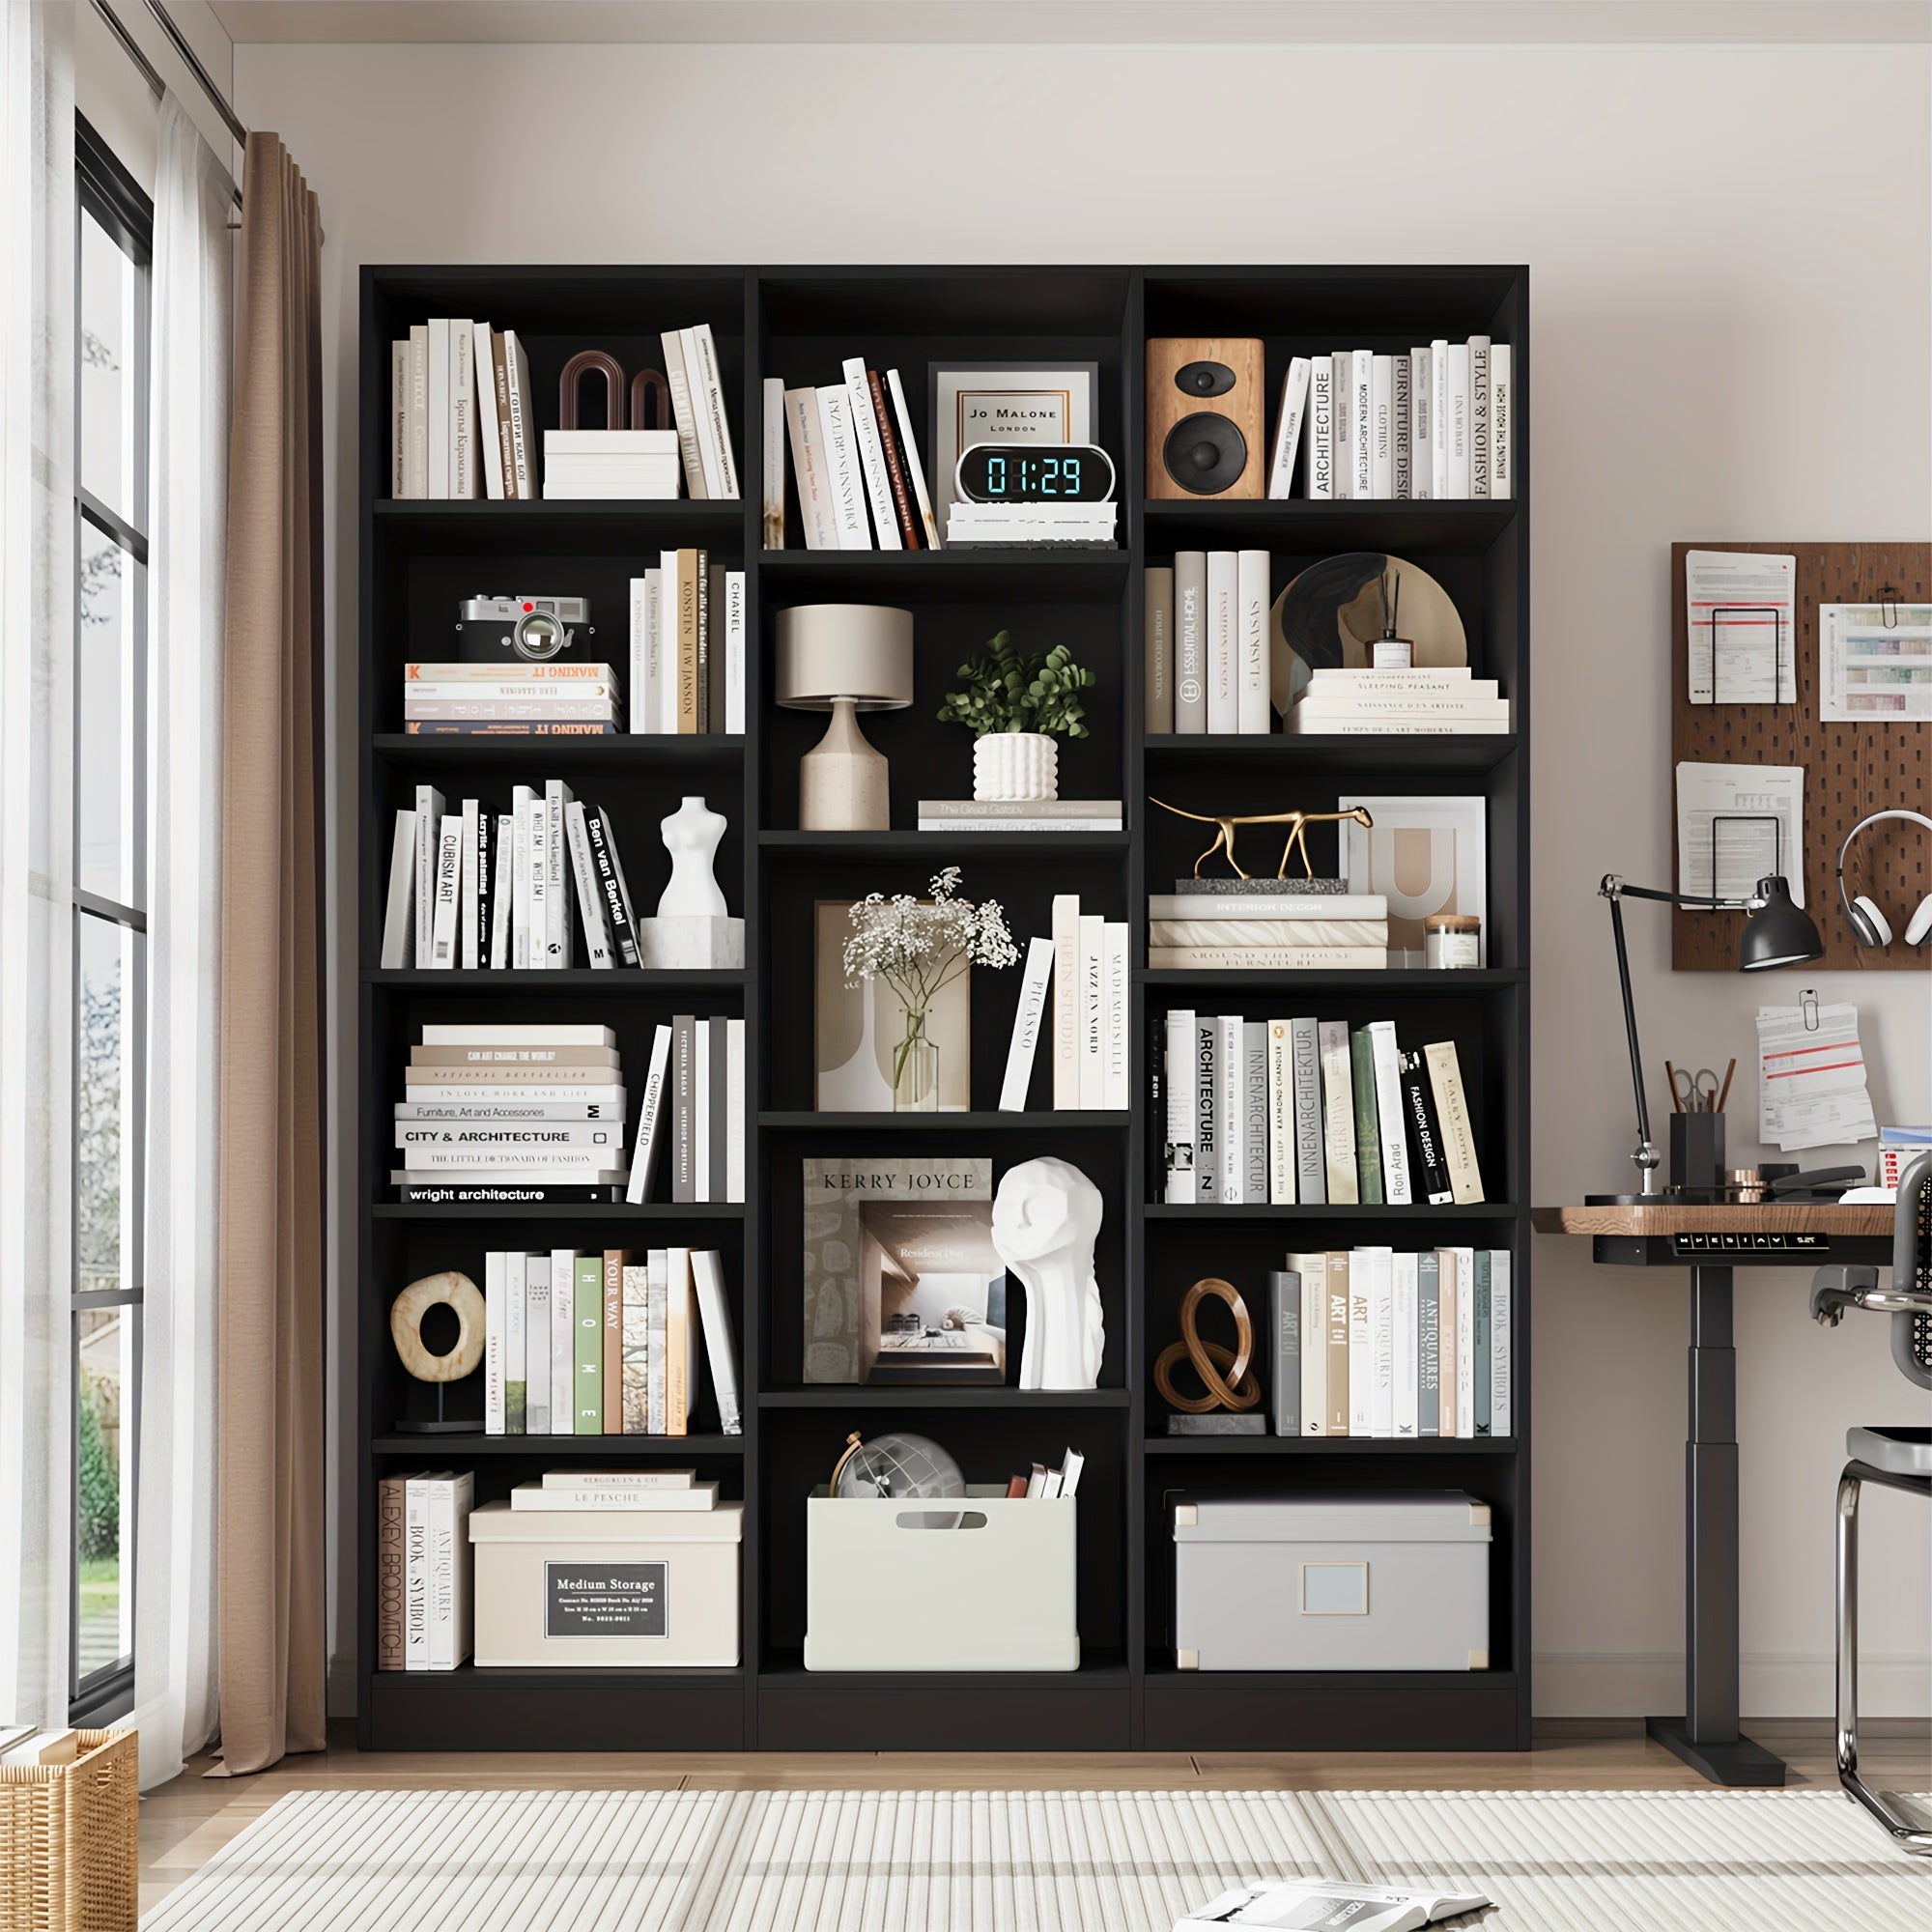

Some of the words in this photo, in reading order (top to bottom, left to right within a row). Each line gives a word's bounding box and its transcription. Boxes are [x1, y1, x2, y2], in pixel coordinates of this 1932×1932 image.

[1474, 350, 1487, 402] STYLE
[413, 375, 425, 412] ГЕССЕ
[670, 370, 693, 421] СПАСИТЕ
[1358, 384, 1368, 423] MODERN
[1397, 358, 1408, 453] FURNITURE
[1418, 399, 1427, 414] LOUIS
[1454, 395, 1464, 414] LINA
[1496, 384, 1506, 403] HOME
[454, 399, 468, 433] Братья
[511, 391, 523, 439] ГОВОРИ
[1284, 412, 1297, 440] MARCEL
[1418, 414, 1427, 440] SULLIVAN
[1454, 417, 1464, 430] BO
[1474, 406, 1487, 418] &
[1496, 405, 1506, 428] HOUSE
[1317, 373, 1329, 494] ARCHITECTURE
[1338, 418, 1347, 442] SULLIVAN
[1378, 404, 1387, 460] CLOTHING
[1454, 431, 1464, 458] BARDI
[1496, 430, 1506, 443] THE
[454, 435, 468, 495] Карамазовы
[515, 441, 525, 460] КАК
[871, 382, 912, 531] INNENARCHITEKTUR
[1279, 441, 1293, 470] BREUER
[1358, 424, 1368, 492] ARCHITECTURE
[1474, 422, 1487, 495] FASHION
[1496, 445, 1506, 479] BRINGING
[517, 465, 526, 481] БОГ
[987, 458, 1081, 495] 01:29
[698, 578, 708, 592] für
[682, 581, 693, 636] KONSTEN
[698, 611, 708, 625] die
[731, 582, 740, 634] CHANEL
[1184, 587, 1195, 621] HOME
[1154, 610, 1164, 638] HOME
[1249, 600, 1260, 675] LASKASAS
[682, 642, 693, 651] H
[698, 625, 708, 665] sünderin
[1184, 622, 1195, 675] ESSENTIAL
[532, 667, 546, 678] IT
[549, 667, 600, 678] MAKING
[682, 656, 693, 668] W
[1154, 639, 1164, 699] DECORATION
[499, 686, 537, 696] SAARINEN
[680, 668, 693, 716] JANSON
[534, 724, 549, 735] IT
[551, 724, 604, 735] MAKING
[940, 804, 959, 815] The
[478, 813, 488, 849] Acrylic
[532, 834, 544, 847] AM
[588, 817, 606, 847] Ben
[440, 835, 457, 879] CUBISM
[478, 851, 488, 895] painting
[596, 849, 611, 877] van
[440, 880, 454, 904] ART
[532, 883, 544, 896] AM
[605, 879, 627, 925] Berkel
[1215, 902, 1275, 912] INTERIOR
[1276, 902, 1322, 912] DECOR
[1089, 955, 1098, 988] JAZZ
[1020, 980, 1044, 1049] PICASSO
[1061, 988, 1074, 1061] STUDIO
[1112, 953, 1122, 1078] MADEMOISELLE
[1089, 1016, 1098, 1054] NORD
[1273, 1045, 1284, 1088] CHANDLER
[1201, 1028, 1213, 1152] ARCHITECTURE
[1295, 1029, 1319, 1178] INNENARCHITEKTUR
[415, 1107, 457, 1119] Furniture,
[459, 1107, 472, 1118] Art
[473, 1107, 492, 1118] and
[493, 1108, 546, 1119] Accessories
[639, 1072, 661, 1147] CHIPPERFIELD
[1249, 1049, 1265, 1193] INNENARCHITEKTUR
[1274, 1090, 1284, 1130] RAYMOND
[405, 1131, 439, 1143] CITY
[442, 1131, 454, 1143] &
[459, 1131, 571, 1143] ARCHITECTURE
[1409, 1085, 1430, 1130] FASHION
[1420, 1129, 1437, 1168] DESIGN
[430, 1154, 449, 1164] THE
[1276, 1163, 1285, 1179] BIG
[1388, 1143, 1404, 1171] Arad
[409, 1188, 455, 1202] wright
[458, 1188, 545, 1201] architecture
[824, 1174, 897, 1190] KERRY
[907, 1174, 976, 1191] JOYCE
[1276, 1179, 1285, 1195] THE
[1390, 1174, 1405, 1197] Ron
[899, 1248, 944, 1260] Resident
[607, 1258, 619, 1296] YOUR
[607, 1299, 619, 1330] WAY
[1330, 1293, 1347, 1324] ART
[1352, 1294, 1368, 1324] ART
[1481, 1284, 1490, 1319] DESIGNERS
[1493, 1294, 1506, 1332] BOOK
[1282, 1310, 1297, 1337] ART
[582, 1273, 597, 1417] HOME
[1425, 1298, 1437, 1390] ANTIQUAIRES
[1493, 1345, 1506, 1411] SYMBOLS
[1399, 1424, 1412, 1435] K
[1476, 1423, 1490, 1435] K
[574, 1493, 588, 1503] LE
[593, 1493, 640, 1503] PESCHE
[382, 1485, 401, 1548] ALEXEY
[410, 1524, 425, 1564] BOOK
[437, 1527, 451, 1623] ANTIQUAIRES
[556, 1578, 607, 1590] Medium
[609, 1578, 656, 1593] Storage
[382, 1552, 401, 1659] BRODOVITCH
[410, 1577, 425, 1645] SYMBOLS
